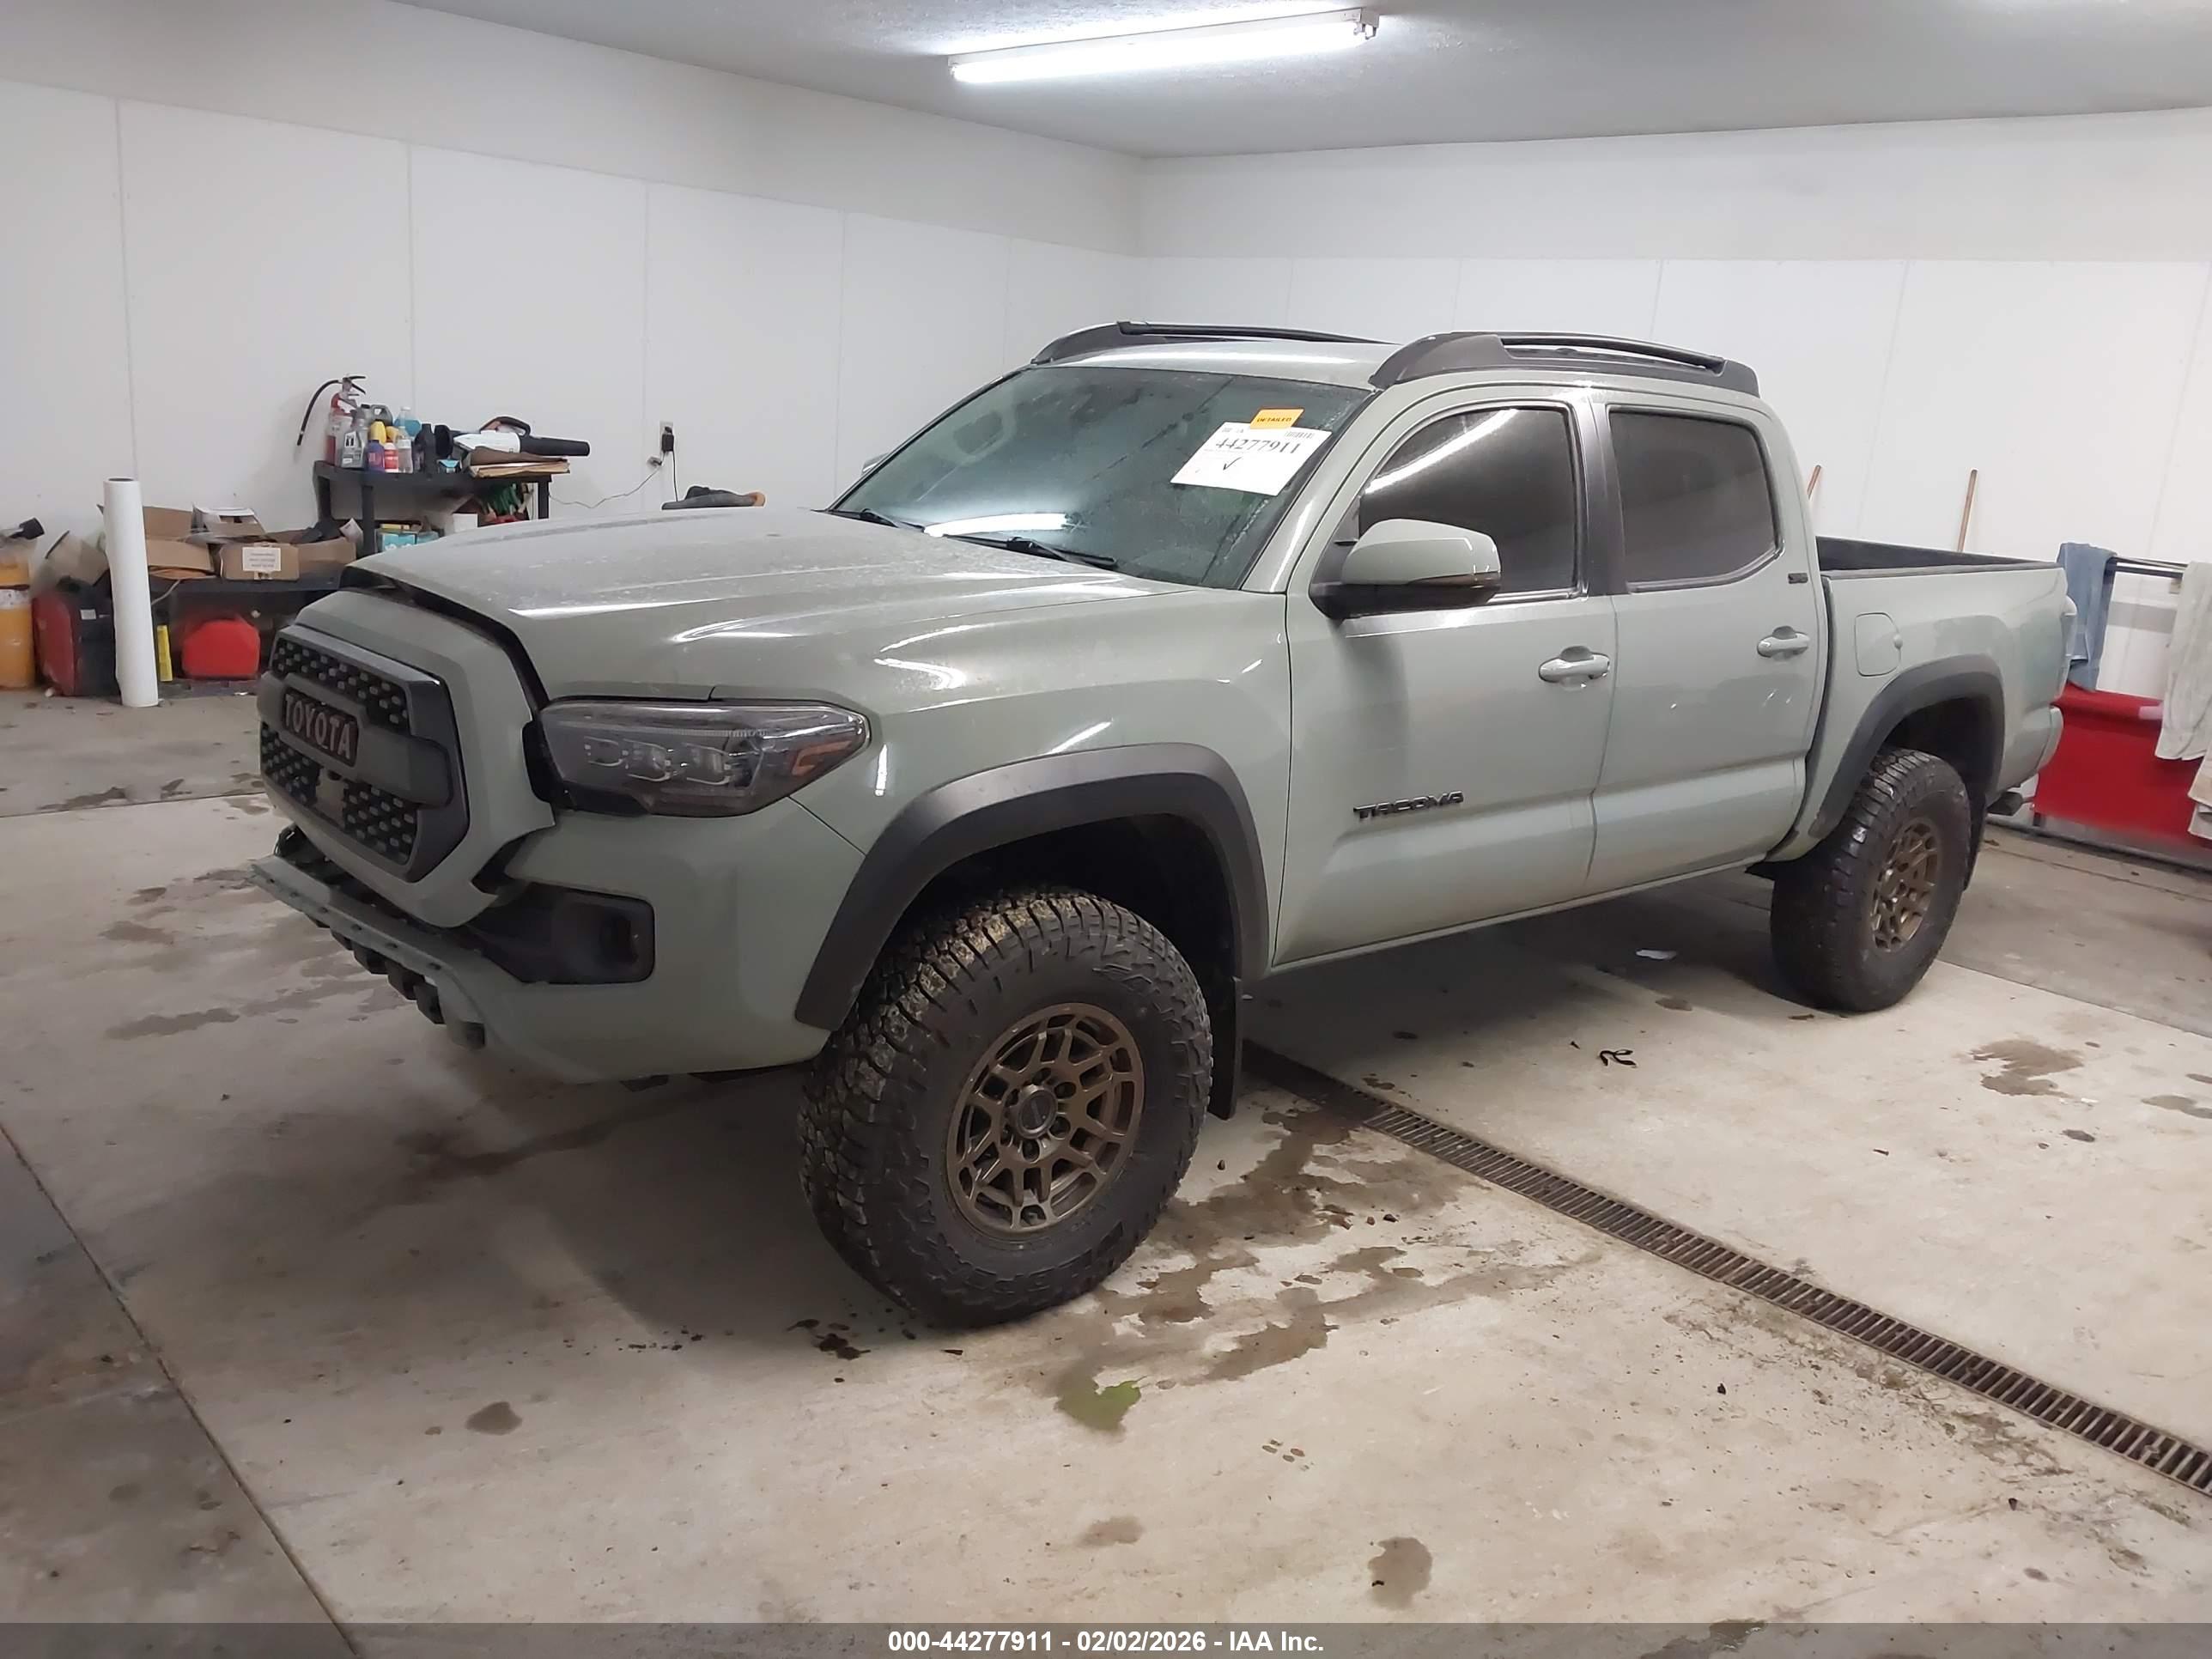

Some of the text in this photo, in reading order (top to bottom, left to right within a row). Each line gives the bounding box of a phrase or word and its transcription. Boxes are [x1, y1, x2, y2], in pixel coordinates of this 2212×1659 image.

[1215, 437, 1301, 454] 44277911
[285, 693, 351, 760] TOYOTA
[1353, 790, 1463, 819] TACOMA
